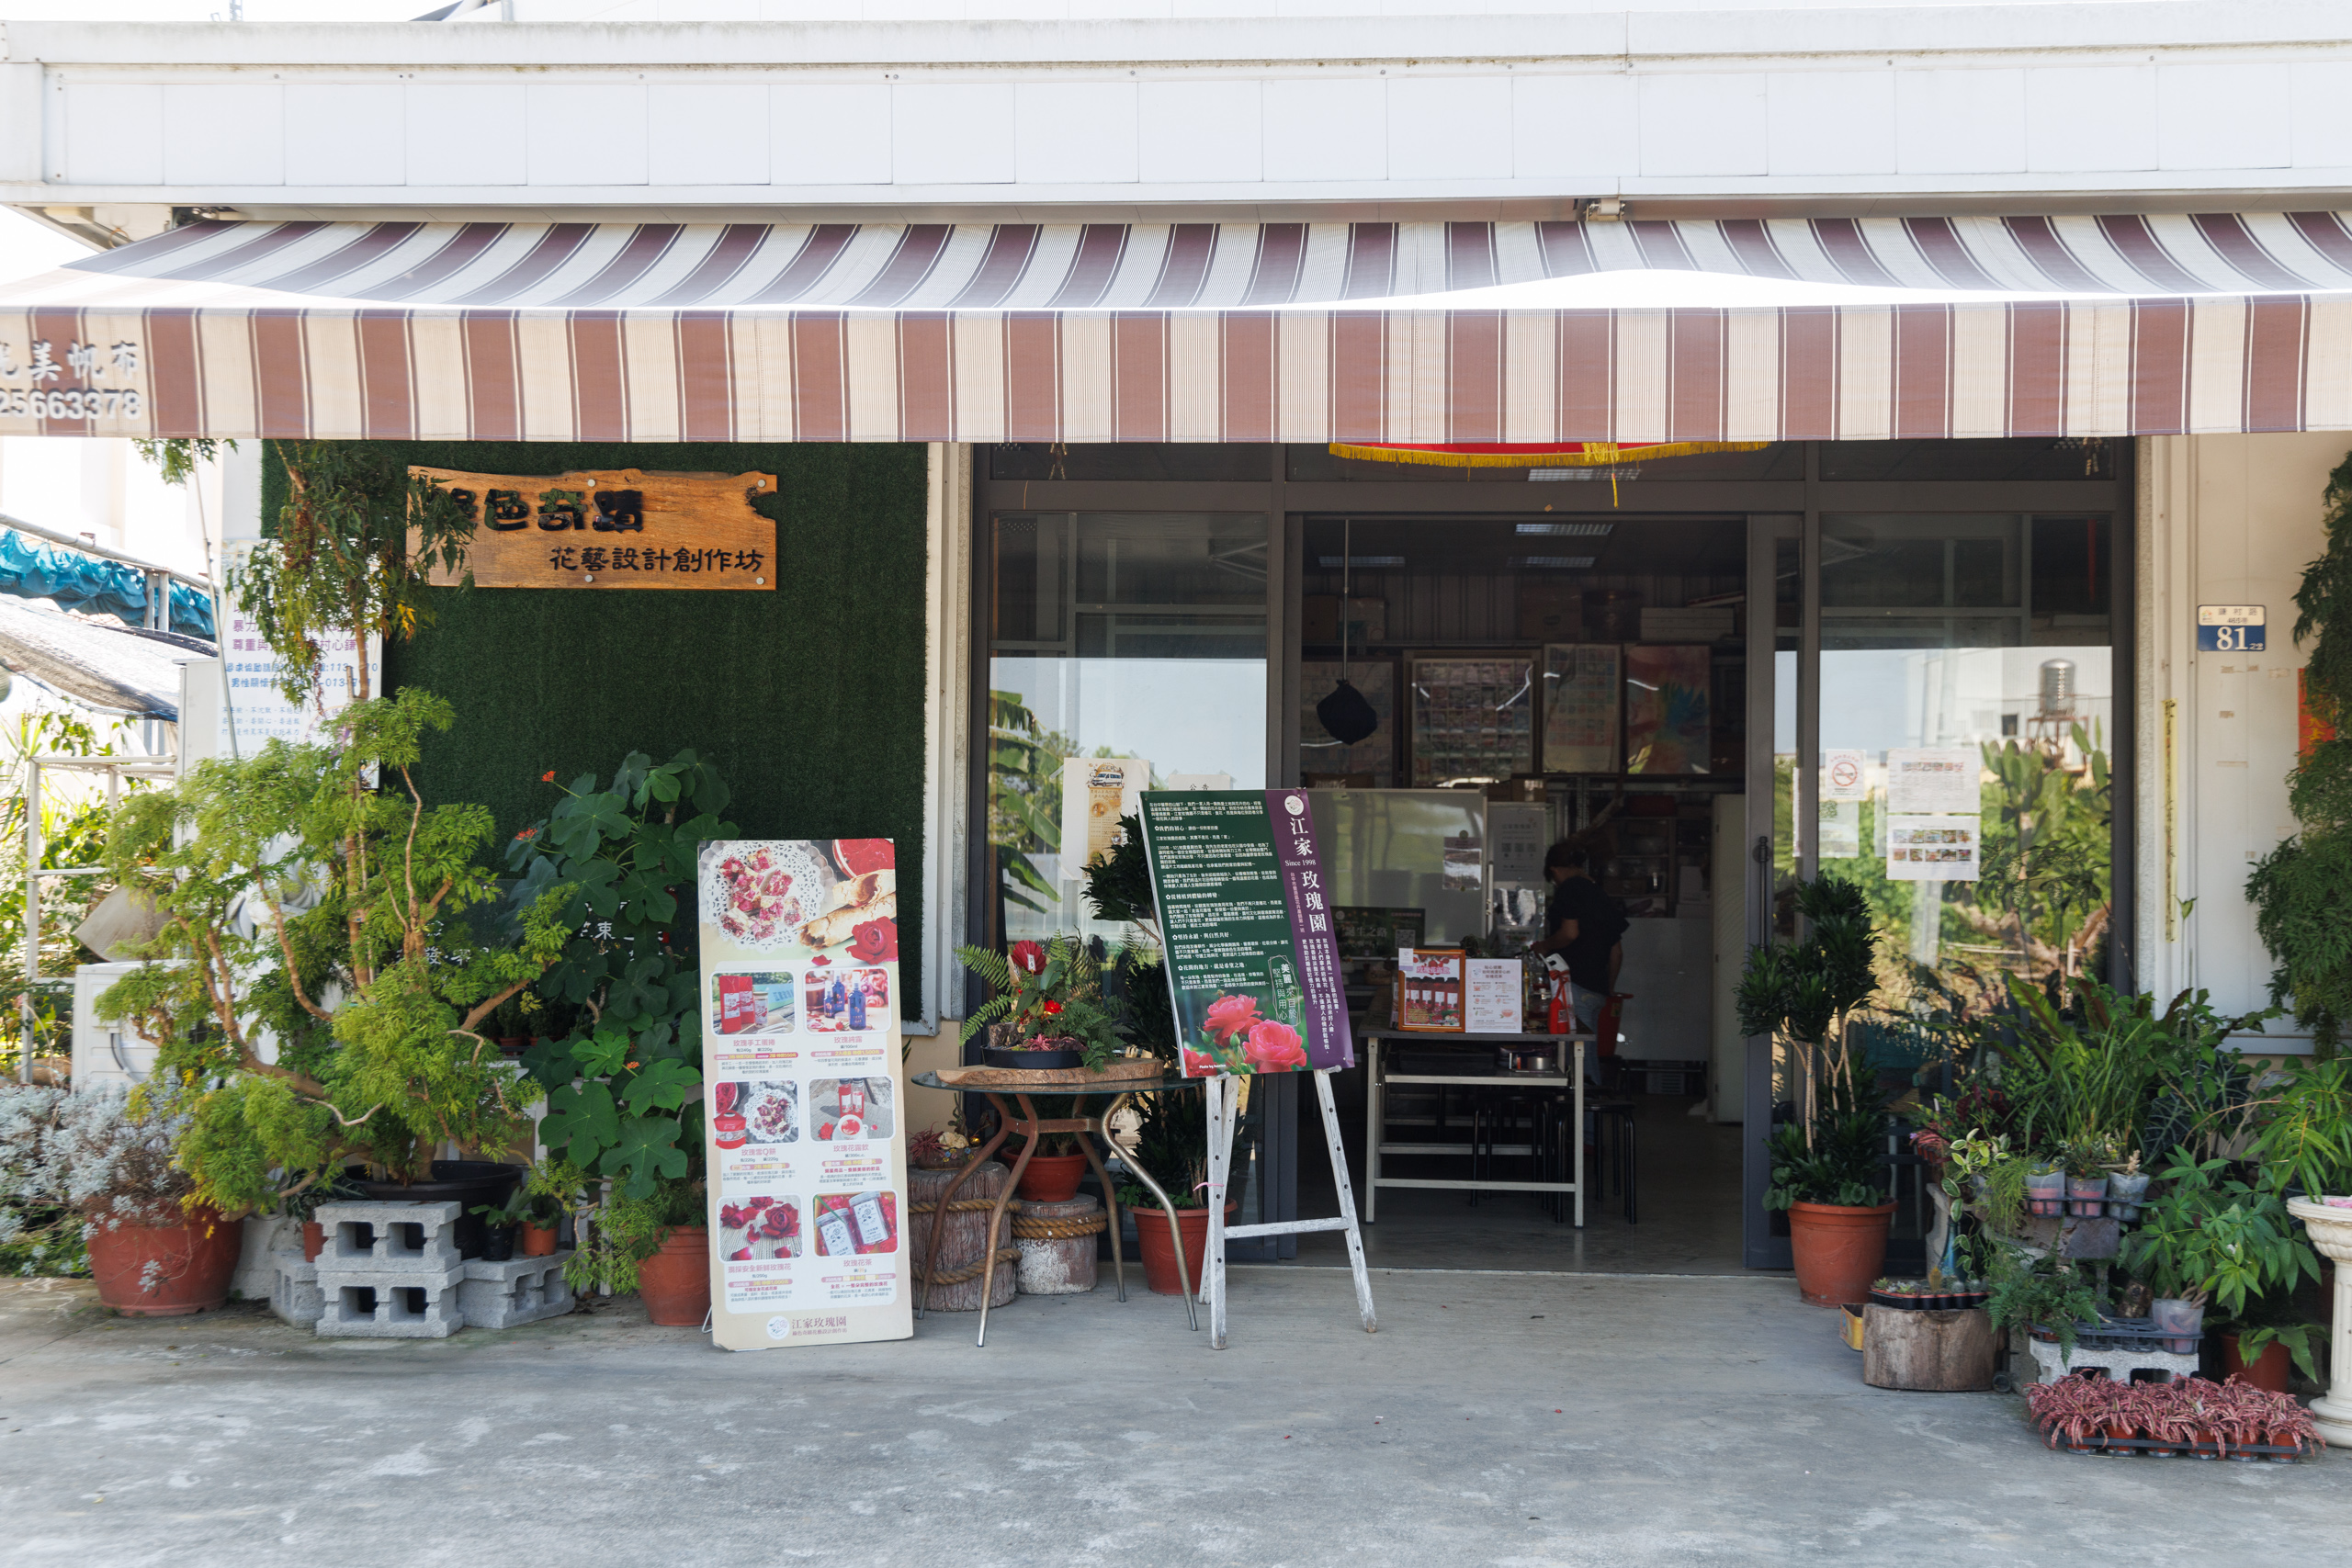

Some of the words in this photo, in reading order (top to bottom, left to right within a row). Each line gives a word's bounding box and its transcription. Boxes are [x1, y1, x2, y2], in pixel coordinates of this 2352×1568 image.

[549, 547, 764, 573] 花藝設計創作坊
[2216, 626, 2248, 650] 81
[1289, 817, 1313, 856] 江家
[1300, 870, 1328, 933] 玫瑰園
[741, 1148, 776, 1156] 玫瑰雪Q餅
[833, 1144, 869, 1152] 玫瑰花露飲
[843, 1258, 873, 1267] 玫瑰花茶
[791, 1315, 847, 1329] 江家玫瑰園
